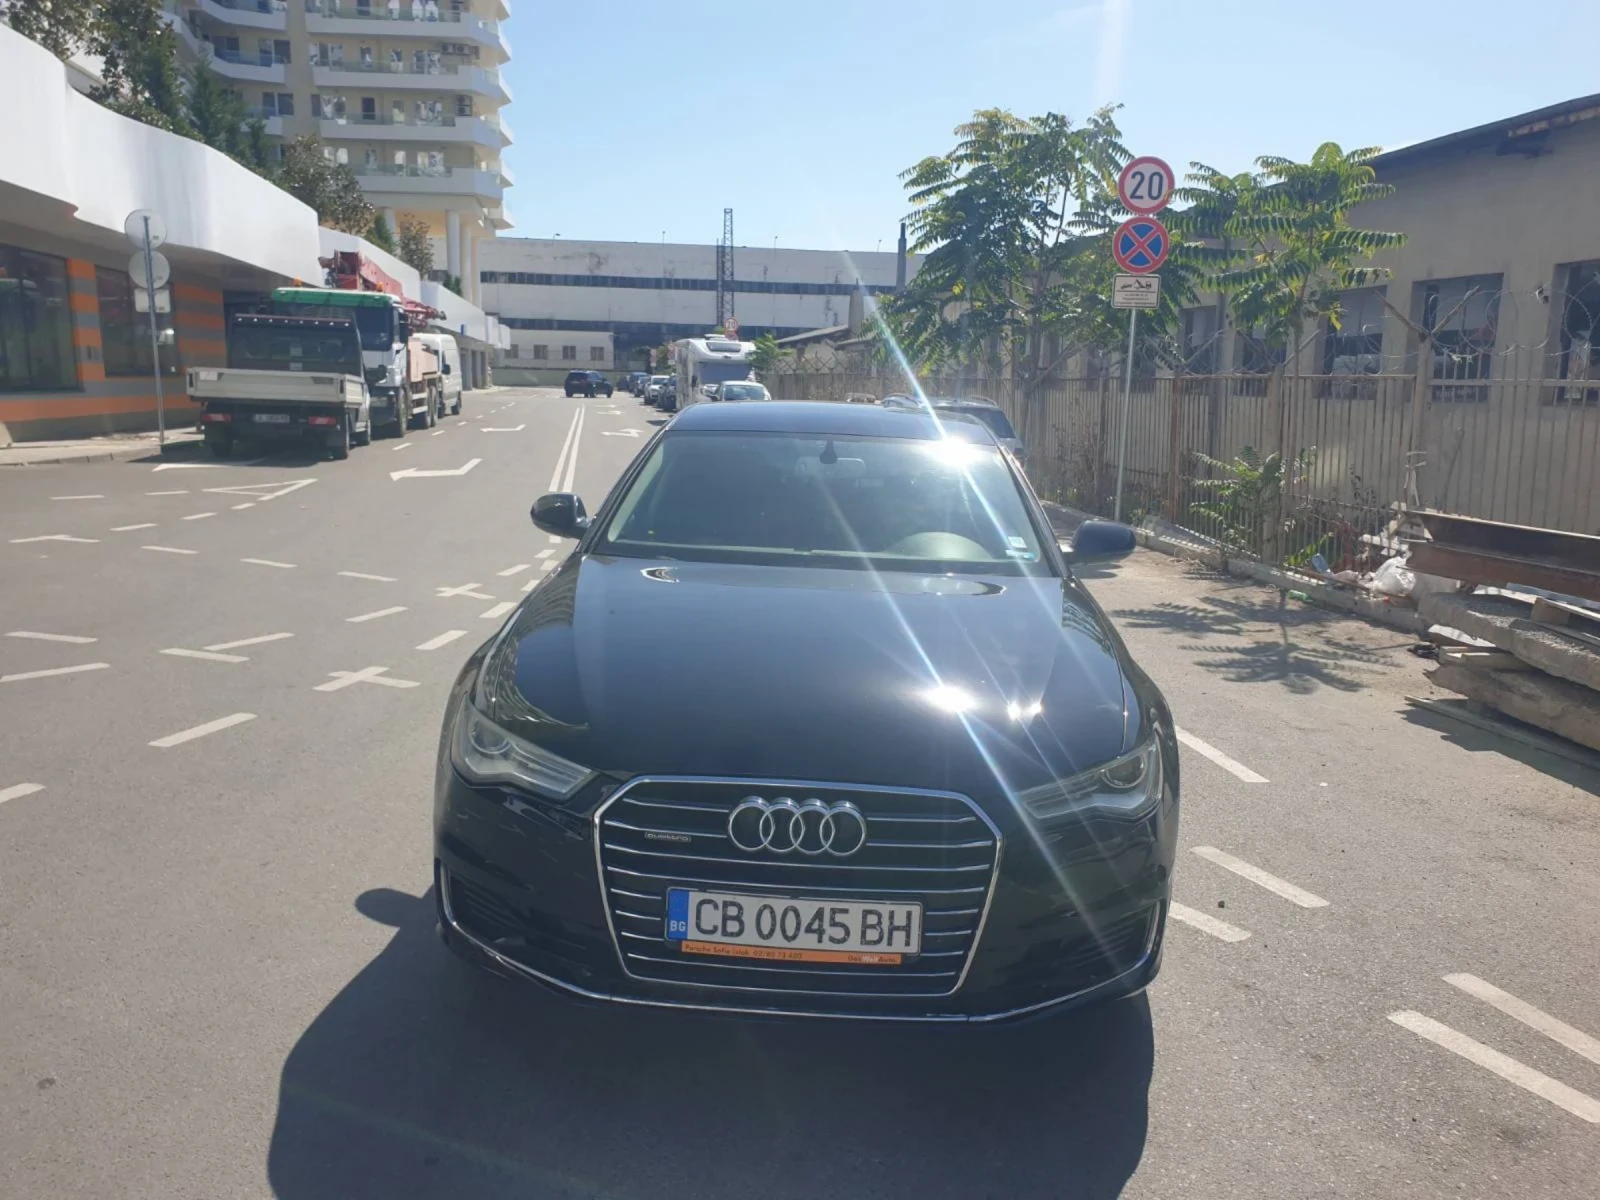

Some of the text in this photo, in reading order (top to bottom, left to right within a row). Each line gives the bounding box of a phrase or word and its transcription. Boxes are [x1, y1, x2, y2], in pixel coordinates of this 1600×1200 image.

[1130, 171, 1164, 201] 20
[669, 920, 687, 932] BG
[695, 898, 913, 947] CB 0045 BH
